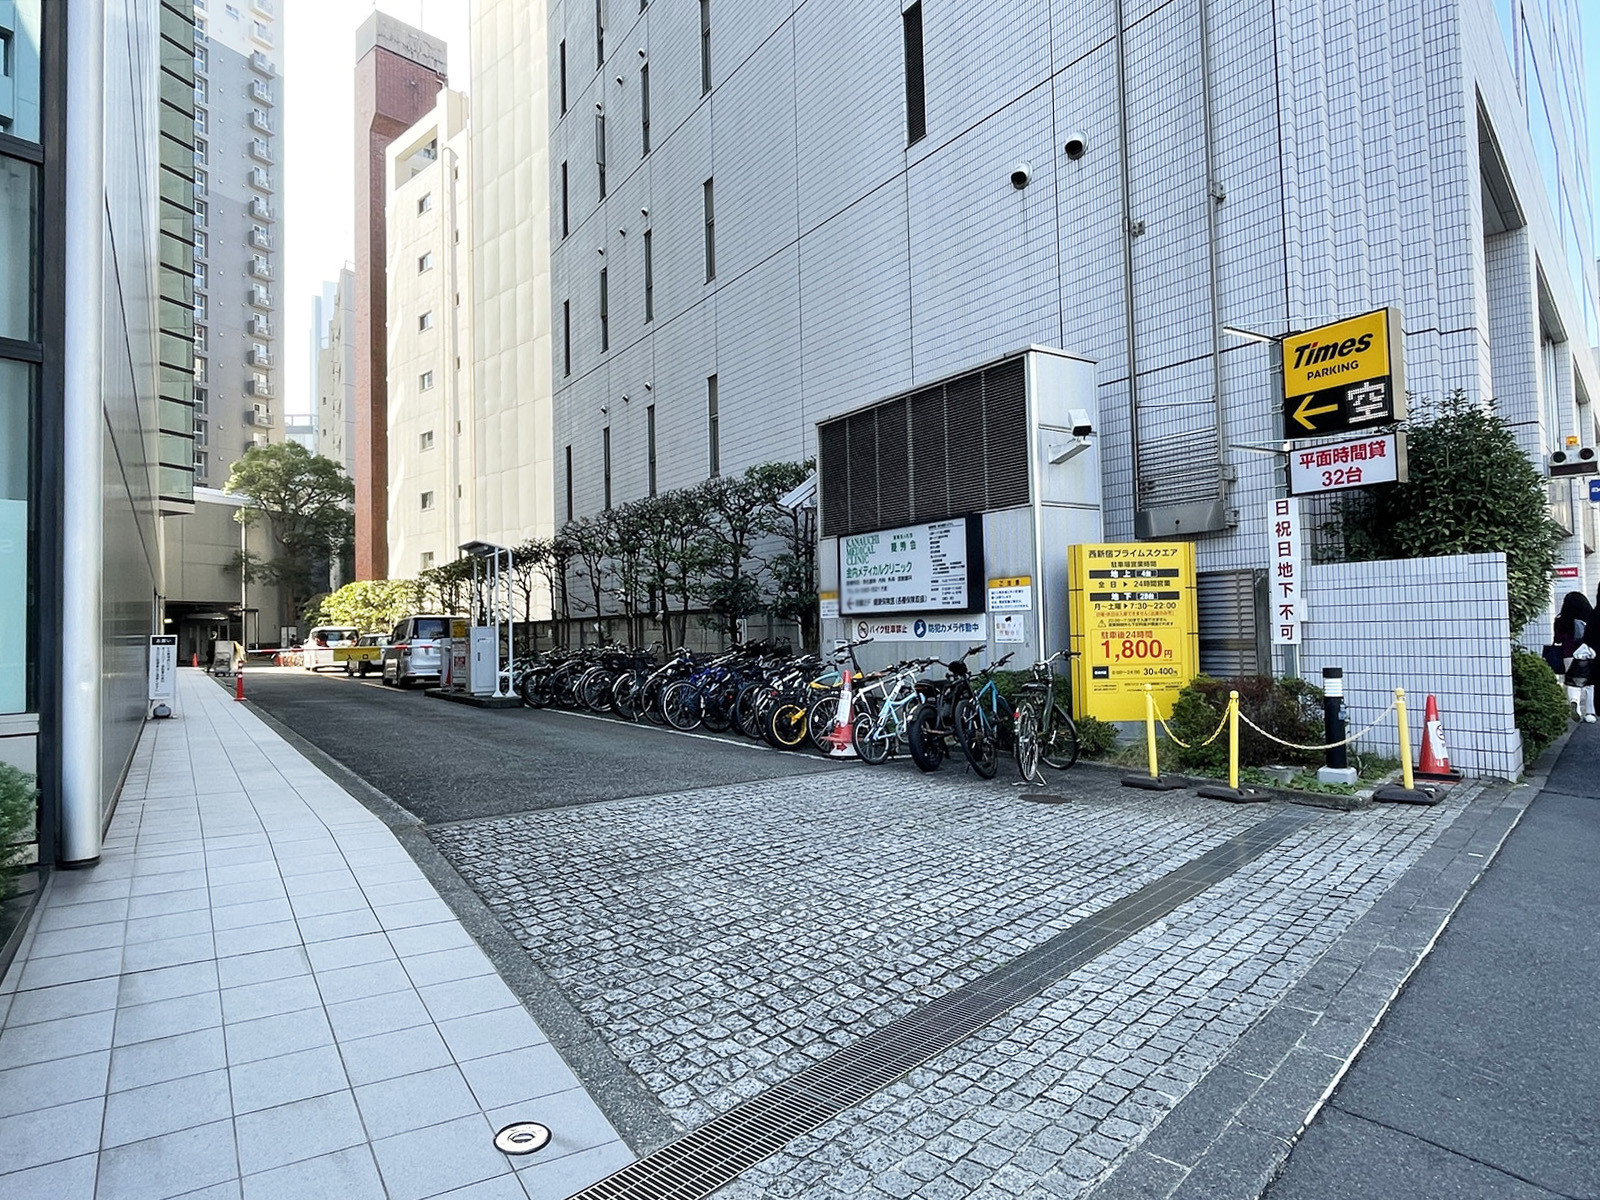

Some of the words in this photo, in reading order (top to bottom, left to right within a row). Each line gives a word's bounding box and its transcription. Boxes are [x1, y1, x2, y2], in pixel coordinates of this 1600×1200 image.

[1293, 332, 1374, 369] Times
[1307, 360, 1359, 381] PARKING
[1347, 381, 1388, 424] 空
[1299, 440, 1386, 469] 平面時間貸
[1321, 467, 1362, 487] 32台
[1088, 548, 1178, 559] 西新宿プライムスクエア
[1275, 500, 1295, 641] 日祝日地下不可
[928, 623, 979, 634] 防犯カメラ作動中
